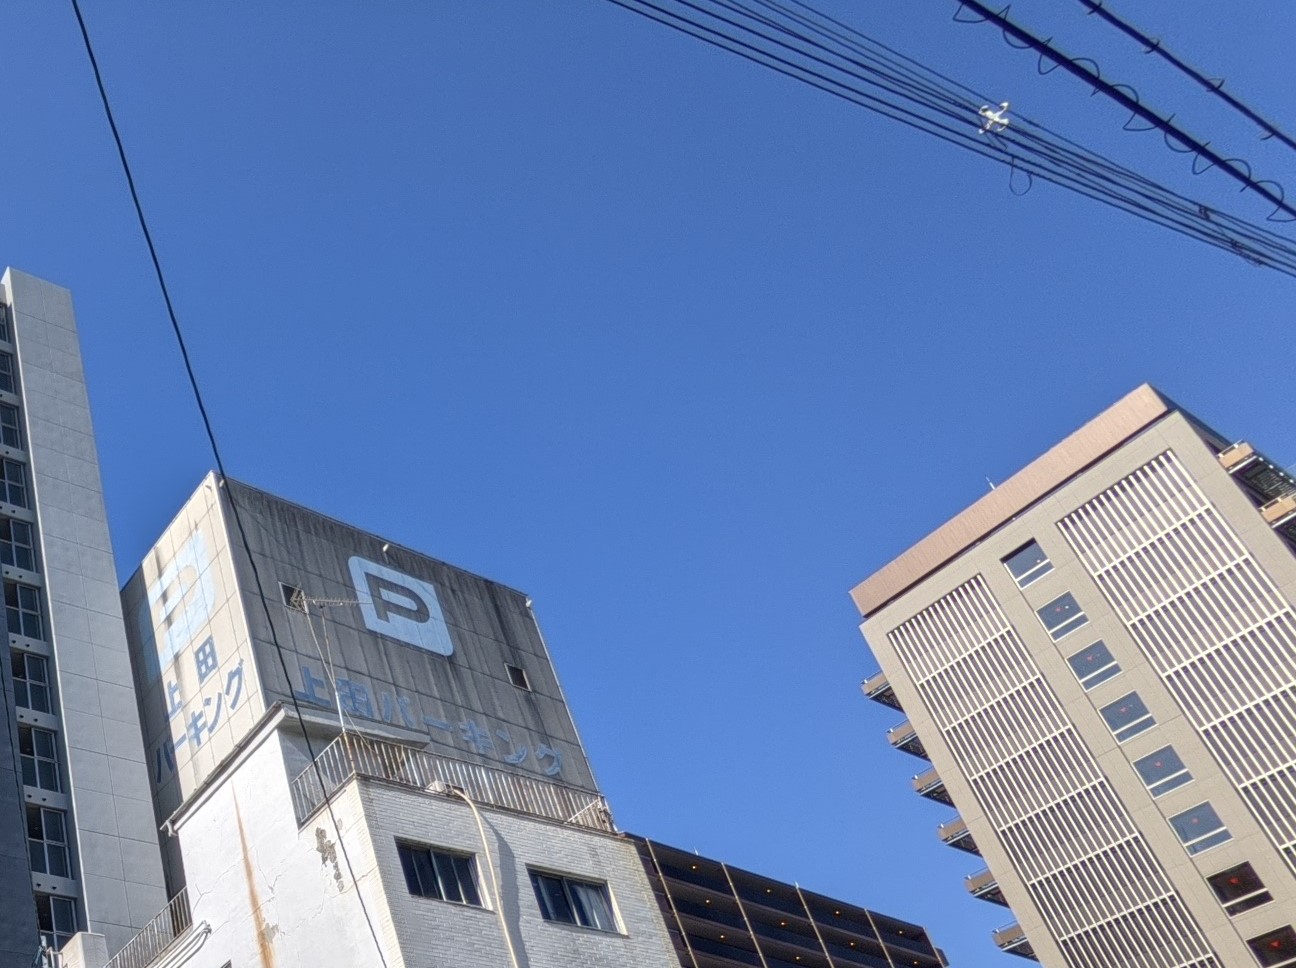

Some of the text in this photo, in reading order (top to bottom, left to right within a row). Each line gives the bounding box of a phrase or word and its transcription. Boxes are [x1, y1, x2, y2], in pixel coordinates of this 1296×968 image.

[156, 658, 244, 784] パーキング
[164, 634, 218, 724] 上田
